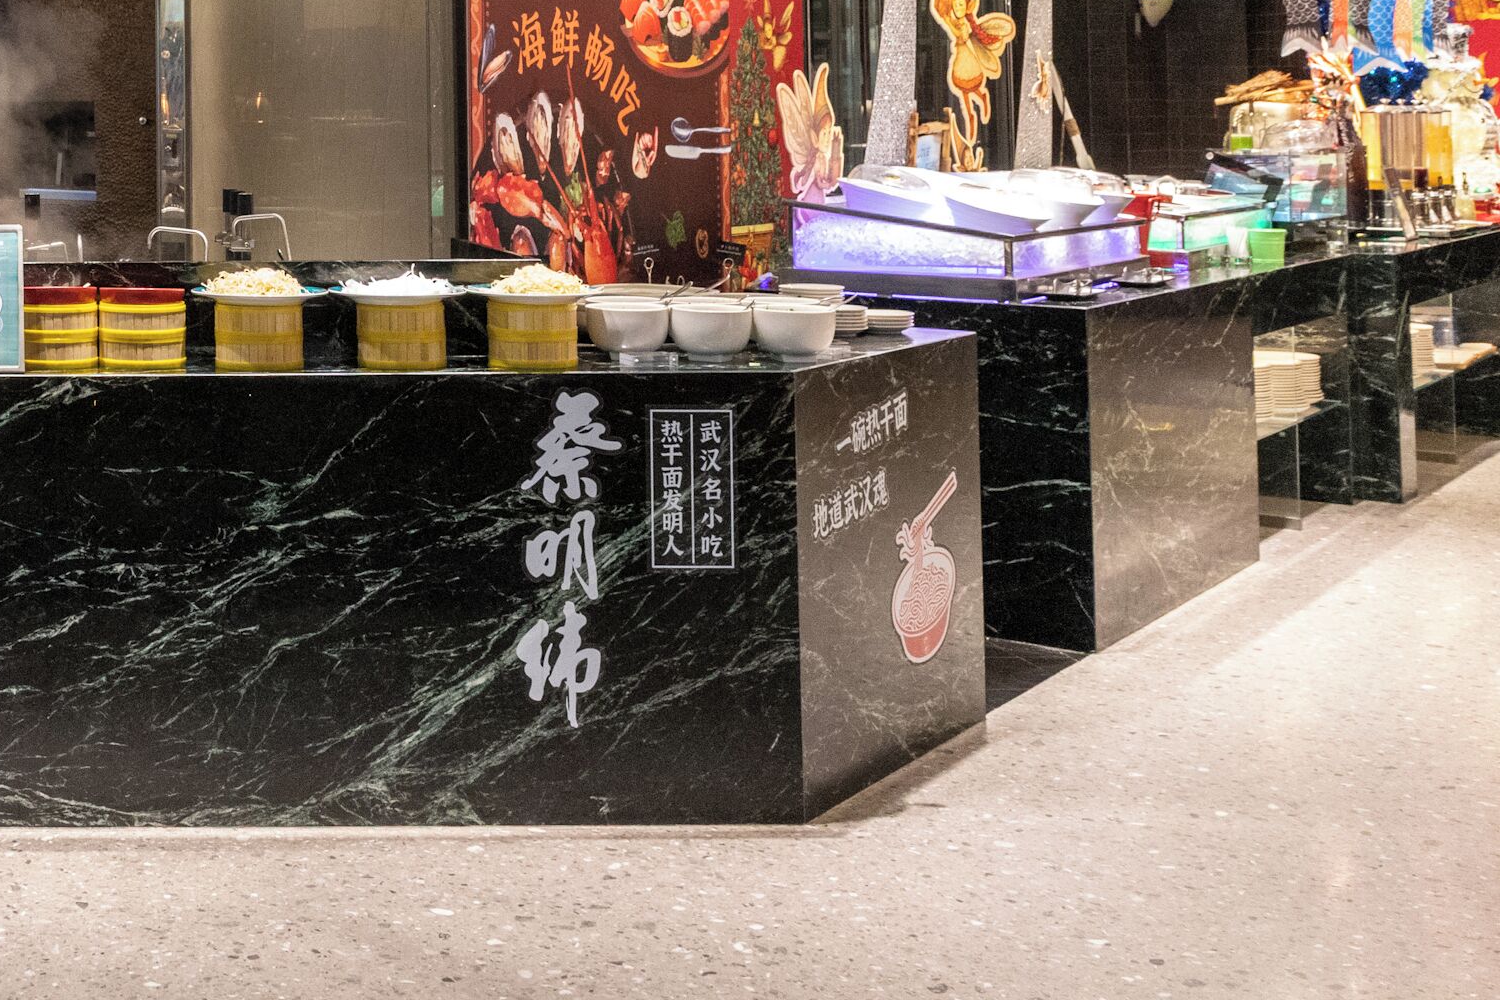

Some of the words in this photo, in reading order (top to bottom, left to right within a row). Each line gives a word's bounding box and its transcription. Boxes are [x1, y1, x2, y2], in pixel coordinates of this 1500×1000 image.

[512, 6, 640, 136] 海鲜畅吃
[836, 392, 907, 452] 一碗热干面
[661, 420, 684, 557] 热干面发明人
[700, 420, 723, 558] 武汉名小吃
[813, 470, 888, 539] 地道武汉魂
